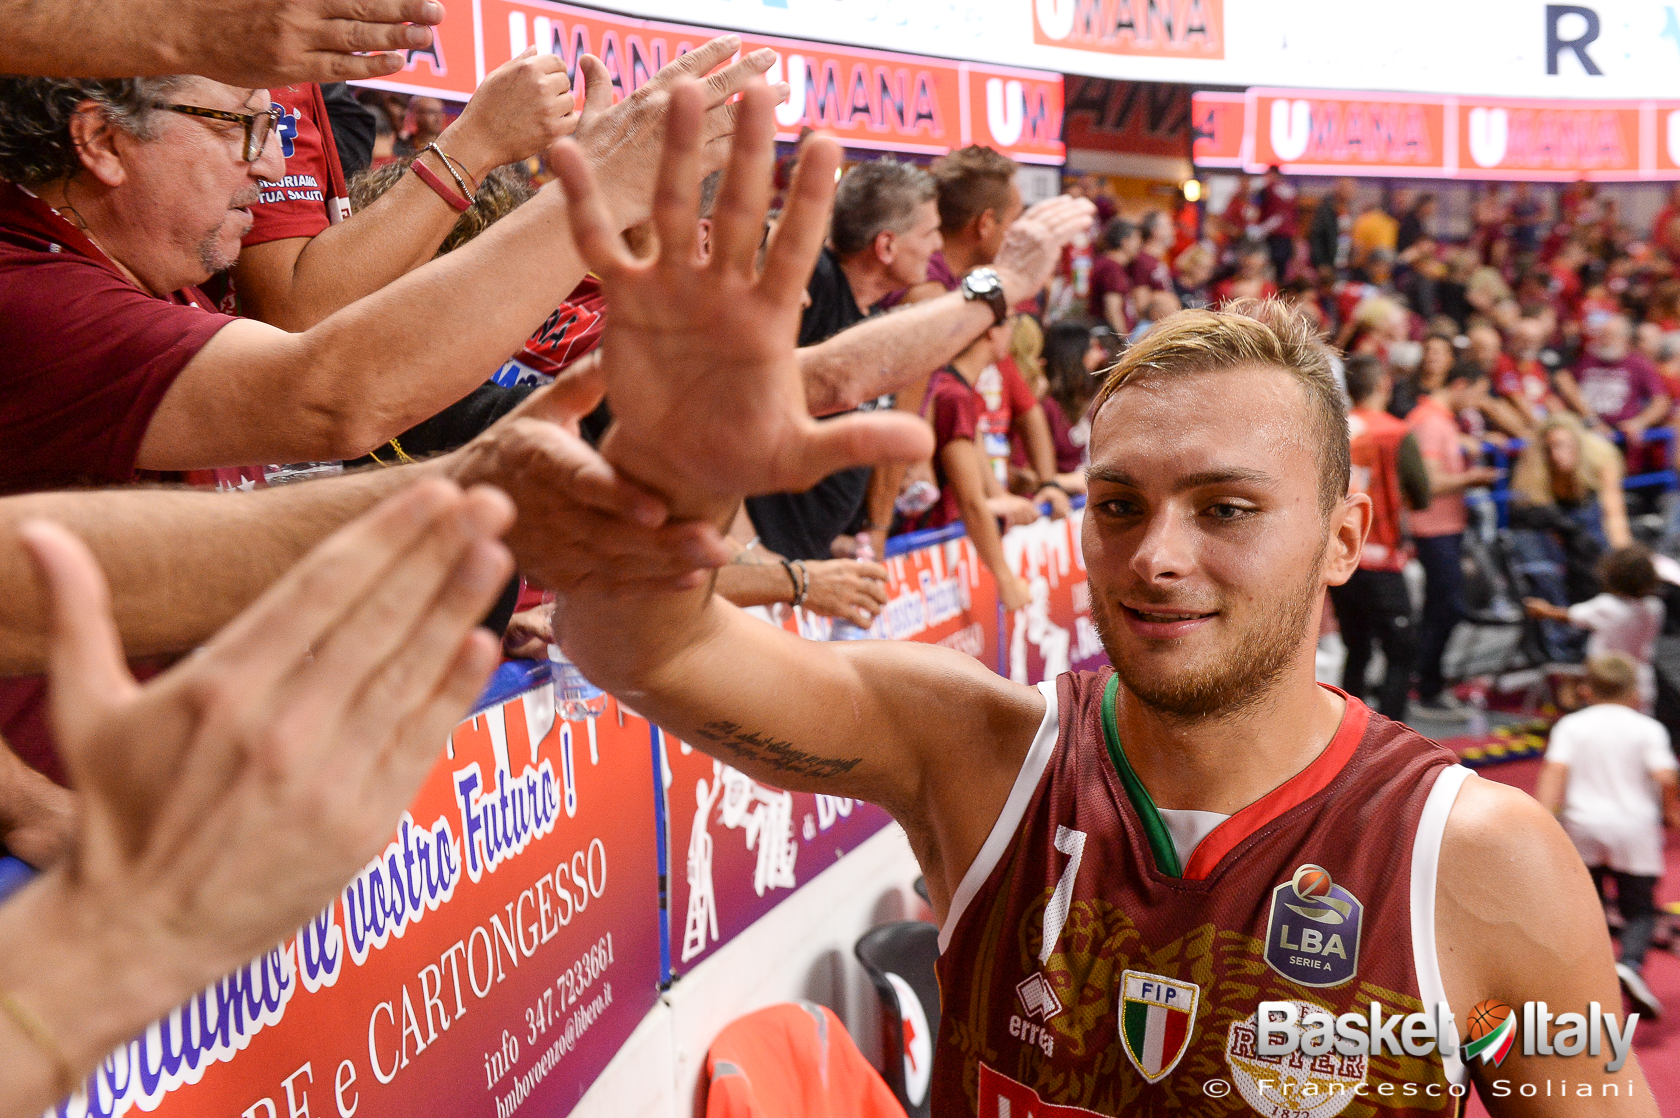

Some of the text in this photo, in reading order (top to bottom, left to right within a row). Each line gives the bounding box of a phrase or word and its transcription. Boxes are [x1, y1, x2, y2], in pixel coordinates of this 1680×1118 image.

[508, 10, 694, 104] UMAN
[1545, 4, 1604, 76] R
[765, 52, 944, 138] UMANA
[287, 189, 324, 202] SALUT
[334, 1059, 359, 1118] e
[367, 837, 607, 1085] CARTONGESSO
[1279, 924, 1347, 960] LBA
[1289, 955, 1332, 972] SERIE A
[483, 931, 614, 1090] info 347.7233661
[1141, 982, 1178, 1004] FIP
